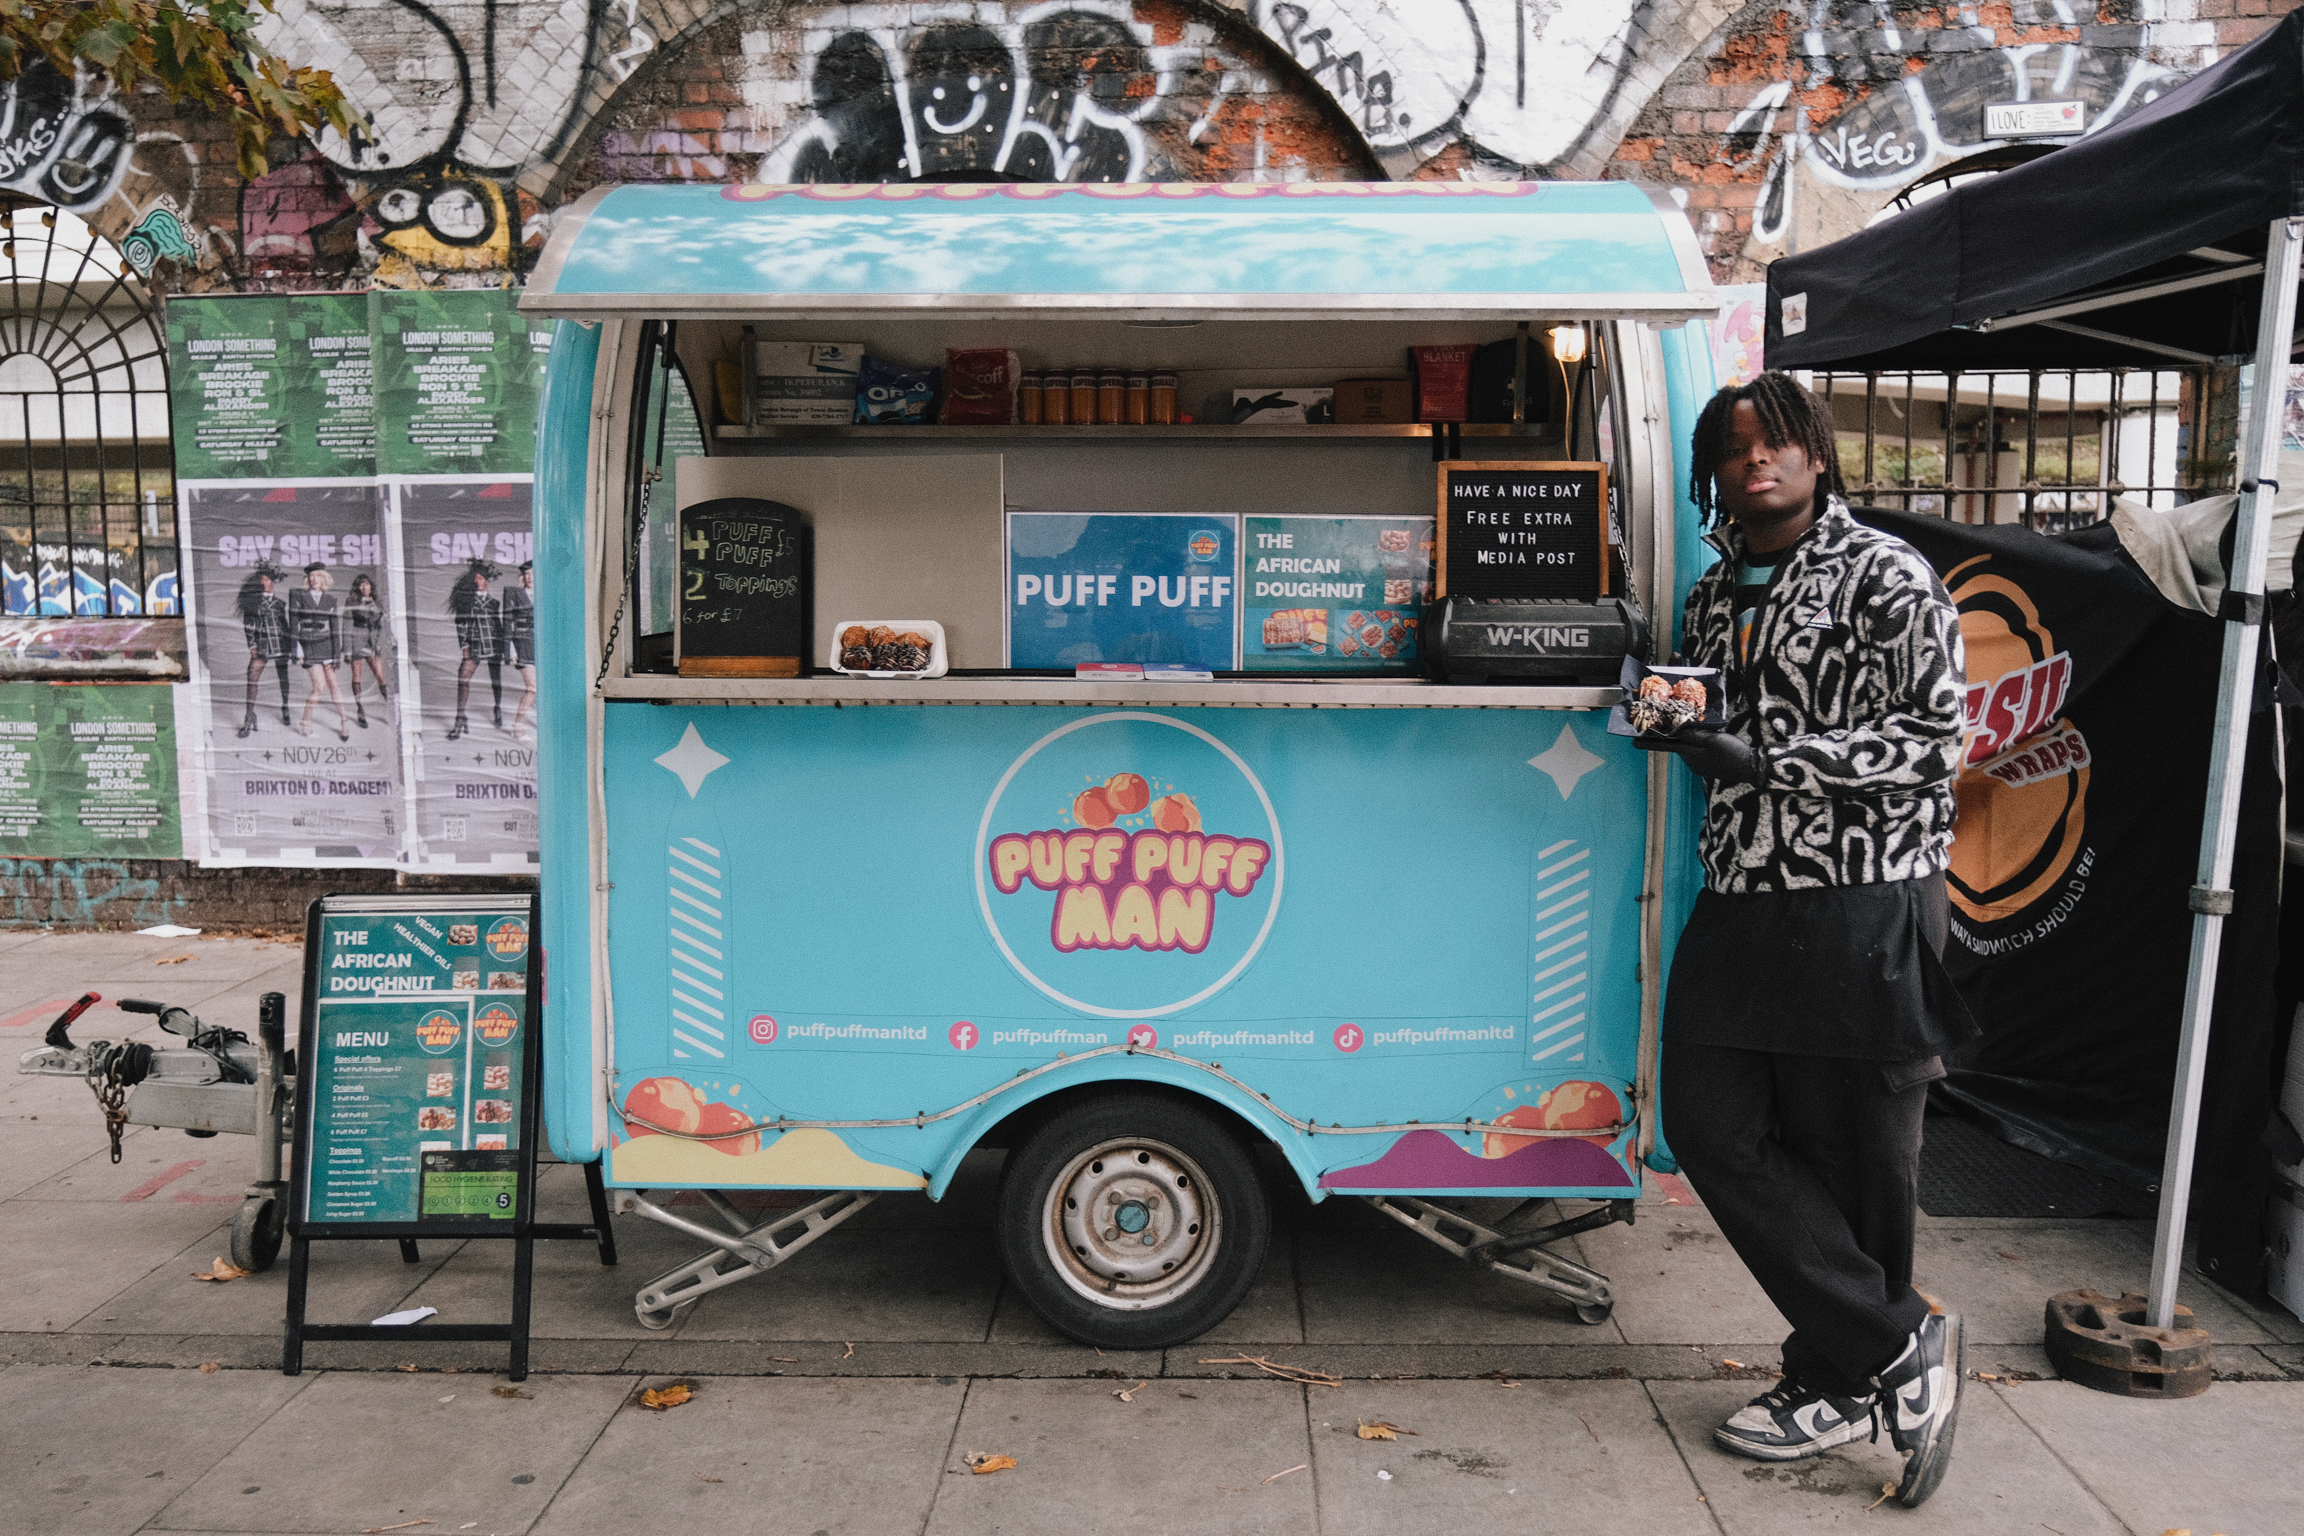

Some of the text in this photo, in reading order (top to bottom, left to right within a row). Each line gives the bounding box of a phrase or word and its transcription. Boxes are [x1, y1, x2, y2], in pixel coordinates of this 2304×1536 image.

[309, 337, 345, 350] LONDON
[403, 331, 494, 345] LONDON SOMETHING
[188, 339, 276, 353] LONDON SOMETHING
[429, 356, 470, 364] ARIES
[1423, 352, 1466, 363] BLANKET
[214, 363, 253, 371] ARIES
[413, 365, 487, 373] BREAKAGE
[198, 371, 270, 381] BREAKAGE
[327, 378, 372, 386] BROCK
[420, 374, 480, 382] BROCKIE
[205, 380, 263, 389] BROCKIE
[326, 387, 354, 395] RON
[418, 383, 447, 391] RON
[204, 389, 232, 398] RON
[204, 402, 269, 411] ALEXANDER
[1323, 404, 1330, 416] L
[1454, 484, 1581, 497] HAVE A NICE DAY
[1467, 511, 1572, 525] FREE EXTRA
[683, 524, 710, 560] 4
[712, 520, 773, 544] PUFF
[1256, 533, 1294, 549] THE
[1498, 532, 1536, 545] WITH
[219, 534, 380, 567] SAY SHE SH
[430, 532, 533, 565] SAY SH
[716, 542, 773, 567] PUFF
[1477, 550, 1575, 565] MEDIA POST
[1255, 557, 1340, 574] AFRICAN
[685, 570, 707, 600] 2
[1017, 574, 1231, 608] PUFF PUFF
[1256, 581, 1366, 598] DOUGHNUT
[682, 608, 692, 624] 6
[697, 610, 718, 623] for
[1486, 627, 1590, 654] W-KING
[70, 722, 157, 734] LONDON SOMETHING
[96, 745, 134, 753] ARIES
[283, 746, 357, 764] NOV 26th
[81, 753, 150, 761] BREAKAGE
[495, 750, 533, 766] NOV
[1986, 732, 2088, 784] WRAPS
[87, 770, 113, 778] RON
[245, 780, 308, 795] BRIXTON
[456, 784, 520, 799] BRIXTON
[293, 817, 306, 826] CUT
[504, 822, 517, 831] CUT
[992, 831, 1268, 894] PUFF PUFF
[1951, 917, 1968, 944] WAY
[2036, 879, 2086, 938] SHOULD
[2076, 846, 2096, 878] BE!
[1053, 883, 1213, 952] MAN
[415, 916, 443, 939] VEGAN
[334, 931, 368, 945] THE
[393, 922, 452, 970] HEALTHIER OILS
[331, 953, 412, 968] AFRICAN
[331, 976, 435, 991] DOUGHNUT
[336, 1031, 389, 1047] MENU
[787, 1023, 927, 1042] puffpuffmanltd
[993, 1028, 1108, 1045] puffpuffman
[1173, 1029, 1314, 1048] puffpuffmanltd
[1373, 1025, 1515, 1046] puffpuffmanltd
[500, 1195, 508, 1207] 5
